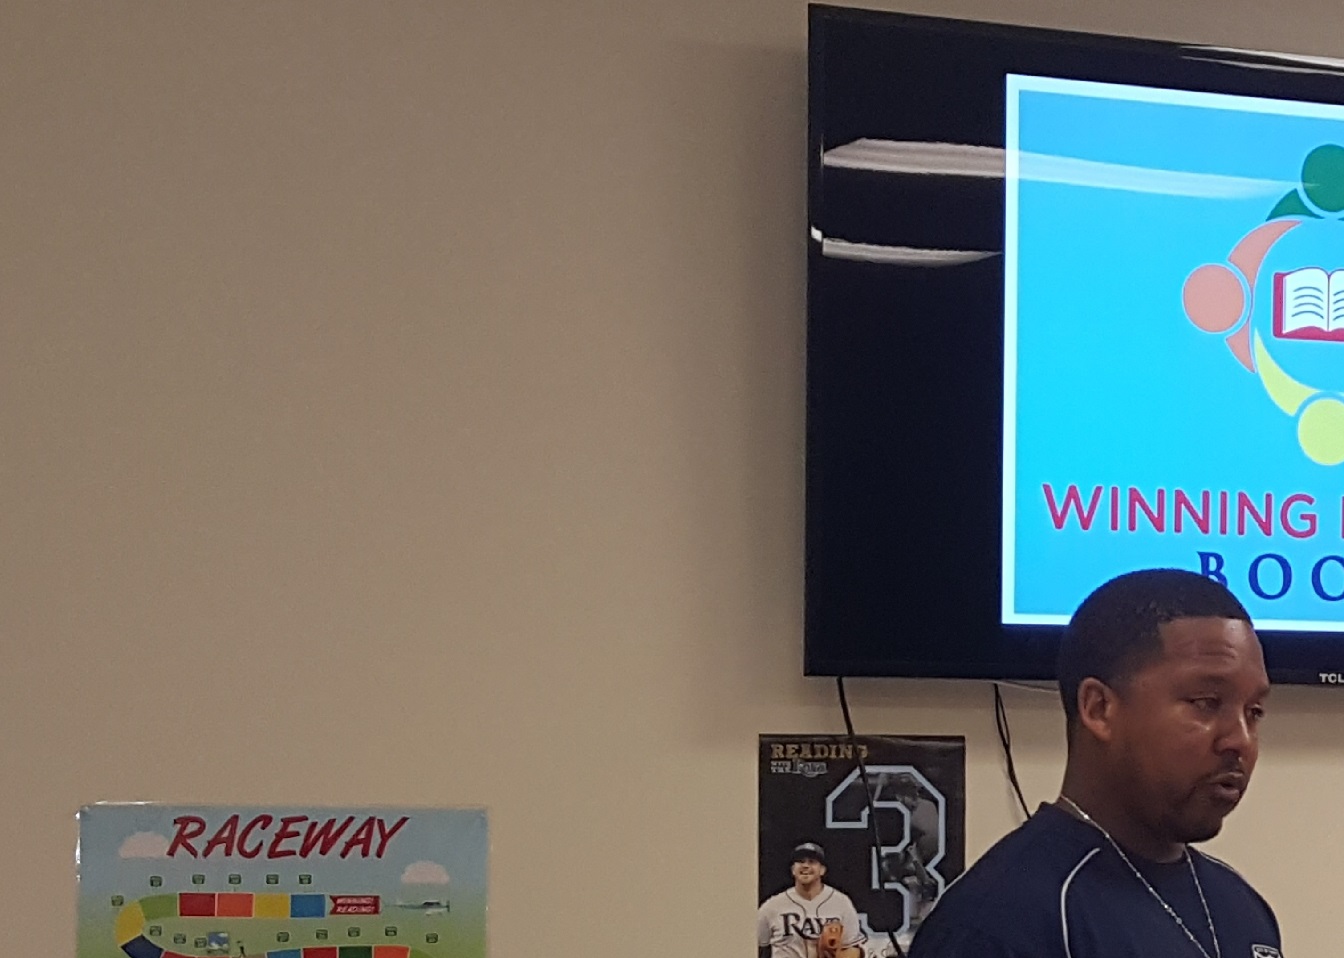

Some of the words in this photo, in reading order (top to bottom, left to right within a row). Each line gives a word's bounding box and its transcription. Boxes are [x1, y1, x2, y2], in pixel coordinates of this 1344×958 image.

[1042, 483, 1317, 539] WINNING
[166, 814, 410, 859] RACEWAY
[780, 912, 841, 940] RAY
